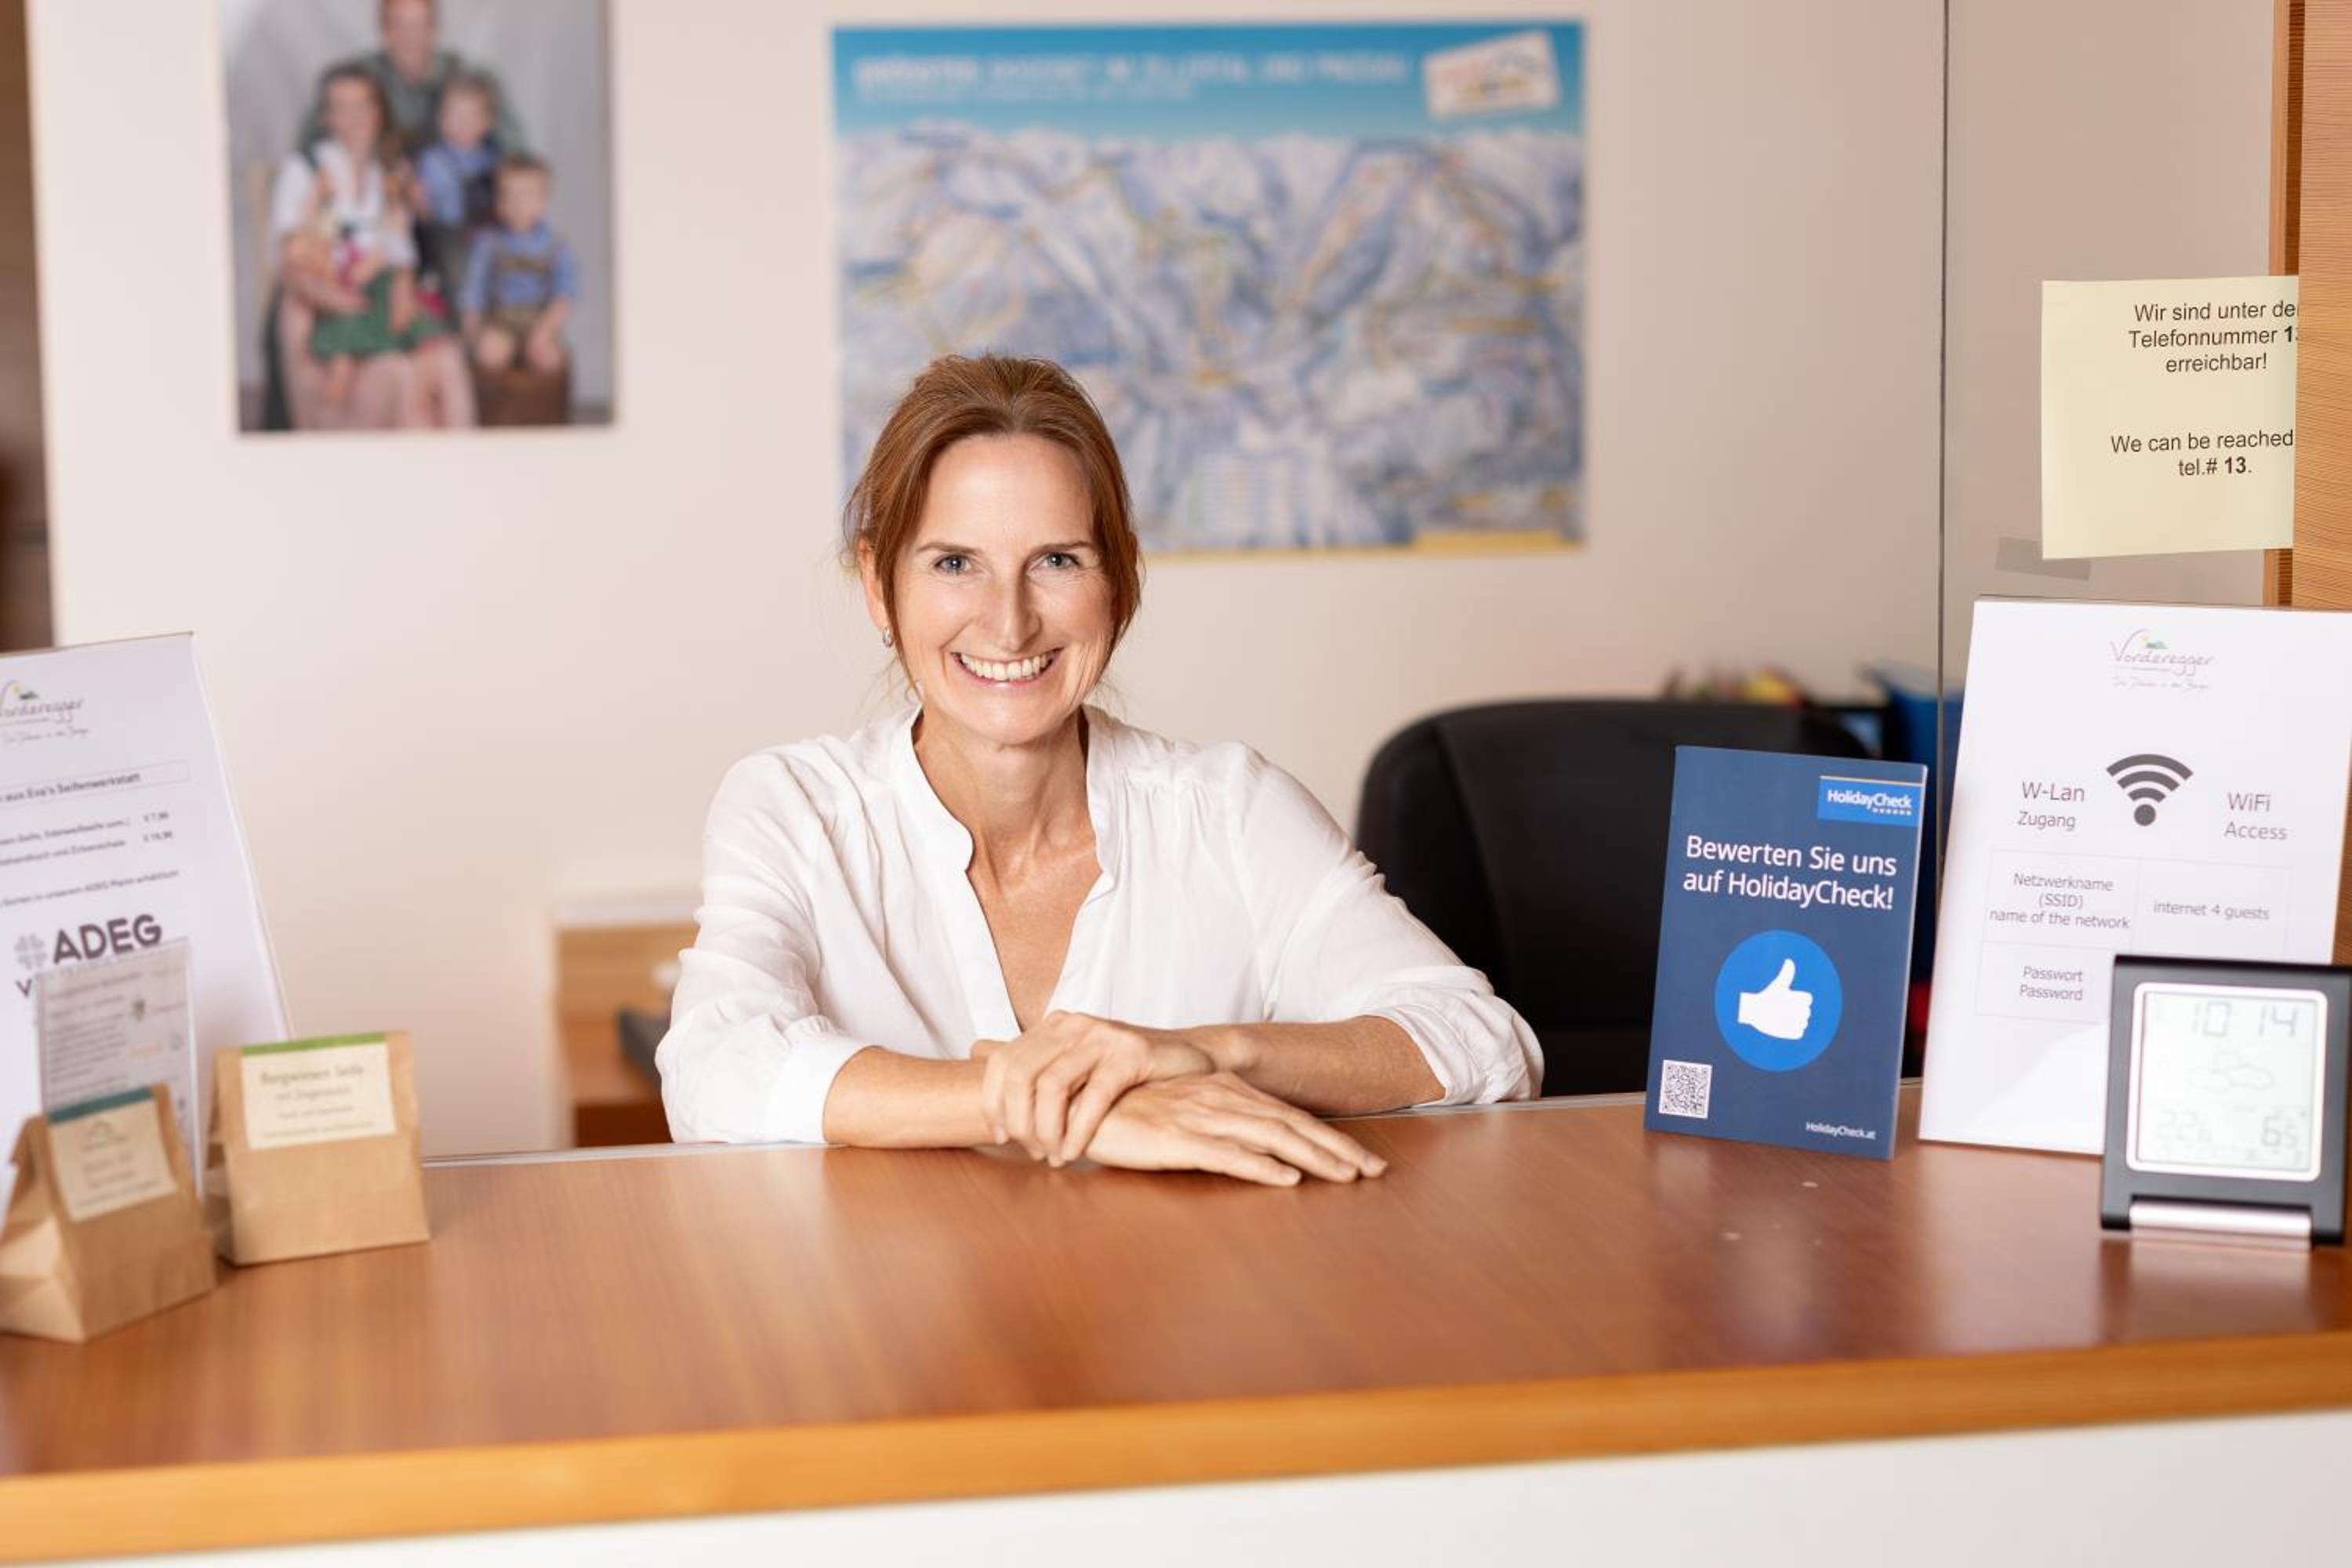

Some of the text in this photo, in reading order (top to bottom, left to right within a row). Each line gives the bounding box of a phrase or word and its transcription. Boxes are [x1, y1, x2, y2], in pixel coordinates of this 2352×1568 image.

[2135, 303, 2166, 322] Wir
[2172, 303, 2211, 321] sind
[2218, 302, 2267, 319] unter
[2129, 325, 2299, 348] Telefonnummer 1
[2165, 353, 2267, 372] erreichbar!
[2111, 430, 2294, 453] We can be reached
[2178, 456, 2252, 476] tel.# 13.
[1827, 789, 1912, 811] HolidayCheck
[2021, 782, 2271, 813] W-Lan WiFi
[2016, 811, 2288, 841] Zugang Access
[1686, 834, 1897, 877] Bewerten Sie uns
[1682, 869, 1895, 909] auf HolidayCheck!
[2013, 872, 2114, 891] Netzwerkname
[2038, 893, 2084, 909] (SSID)
[2153, 900, 2270, 921] internet 4 guests
[1989, 909, 2130, 930] name of the network
[53, 913, 162, 965] ADEG
[2022, 966, 2083, 982] Passwort
[2019, 985, 2083, 1001] Password
[1806, 1120, 1876, 1140] HolidayCheck.at
